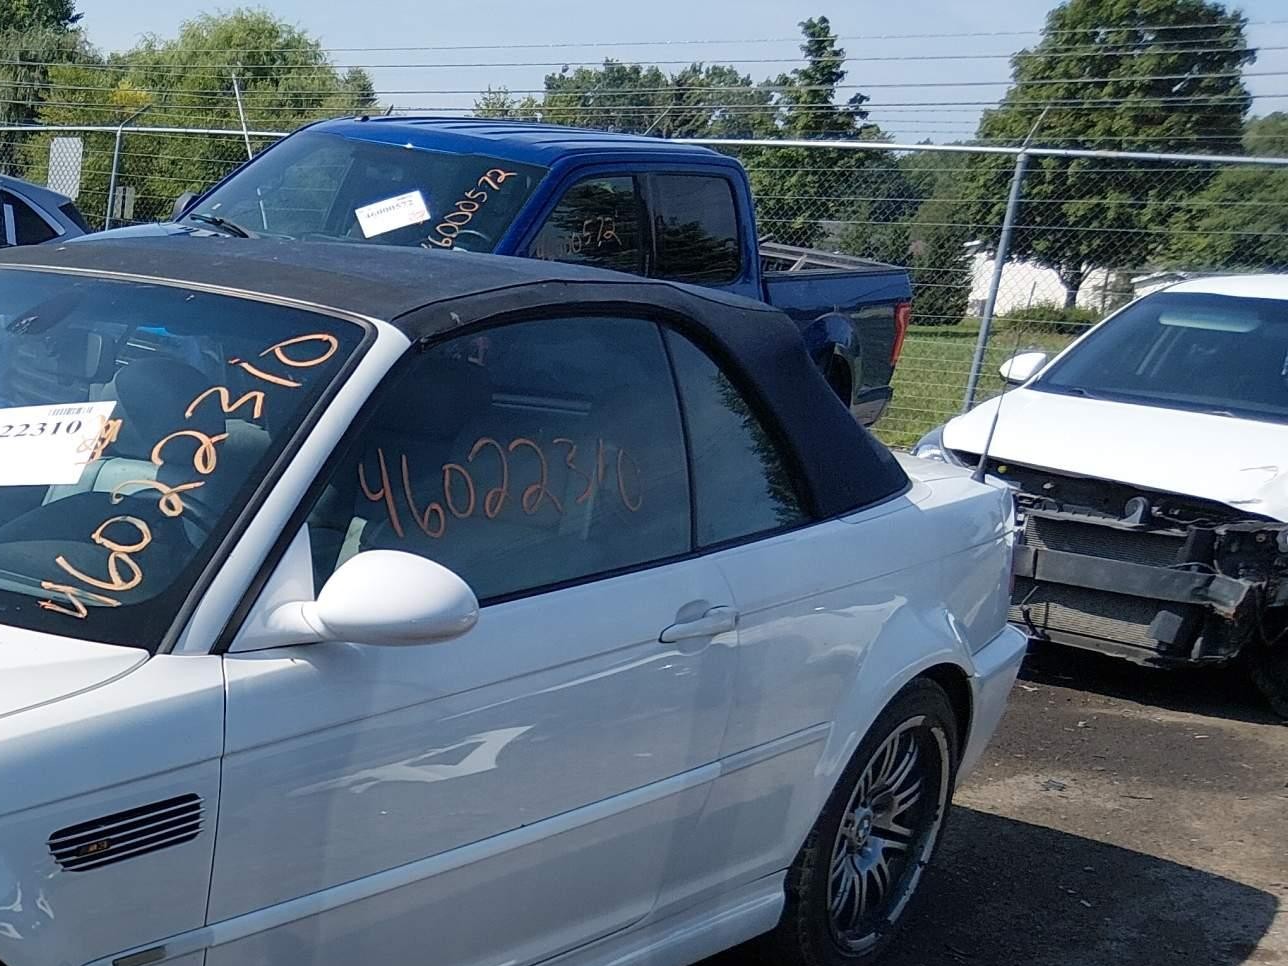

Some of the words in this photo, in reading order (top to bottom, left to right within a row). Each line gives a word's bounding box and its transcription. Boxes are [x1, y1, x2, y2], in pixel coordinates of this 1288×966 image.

[535, 215, 623, 260] 400572
[37, 334, 339, 619] 46022310
[358, 436, 644, 539] 46022310
